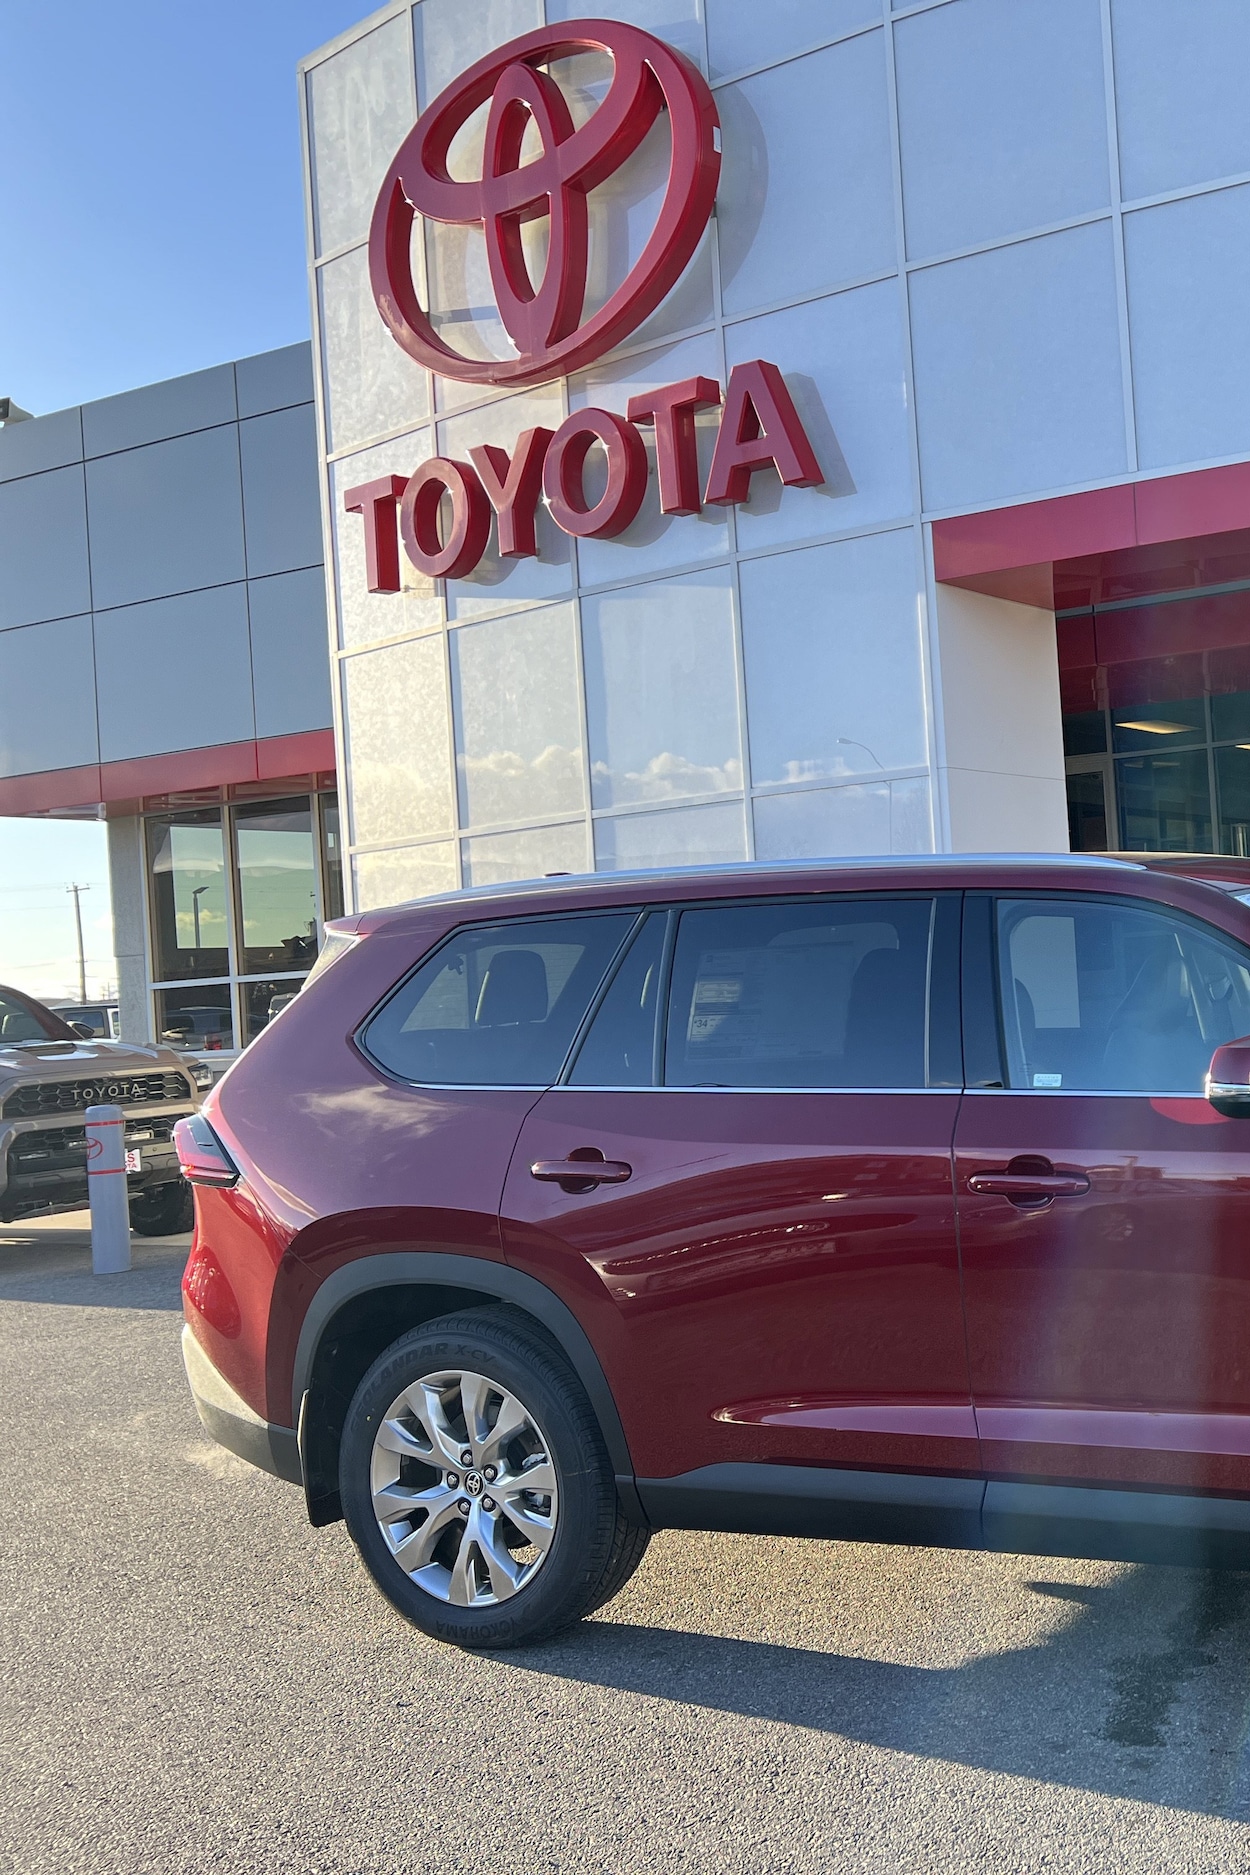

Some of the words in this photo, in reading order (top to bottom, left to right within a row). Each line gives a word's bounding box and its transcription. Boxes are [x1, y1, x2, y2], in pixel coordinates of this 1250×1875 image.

[343, 358, 825, 595] TOYOTA
[71, 1083, 142, 1101] TOYOTA
[125, 1152, 135, 1163] S
